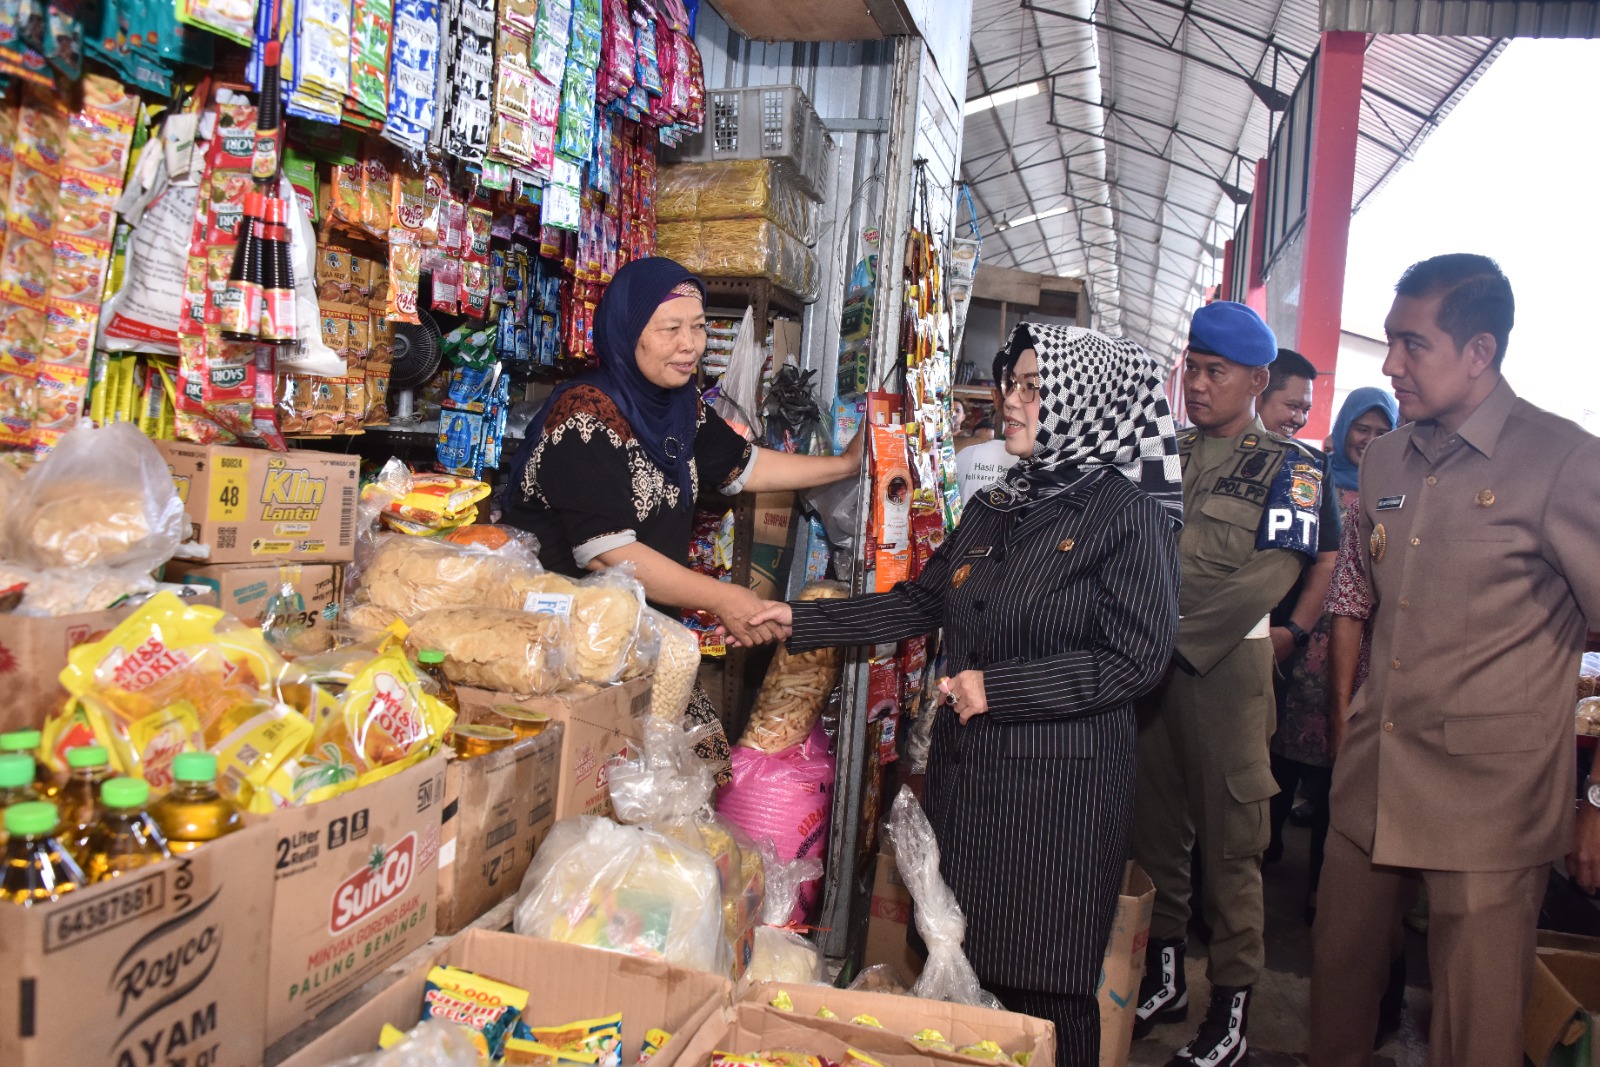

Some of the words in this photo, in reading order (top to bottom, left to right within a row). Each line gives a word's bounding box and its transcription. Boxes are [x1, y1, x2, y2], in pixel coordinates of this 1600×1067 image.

[225, 138, 254, 151] AORI
[212, 367, 245, 382] SAORI
[974, 462, 995, 472] Hasil
[219, 486, 240, 508] 48
[260, 468, 327, 505] Klin
[1216, 480, 1242, 496] POL
[1244, 486, 1265, 500] PP
[260, 504, 321, 522] Lantai
[763, 512, 788, 527] SIMPAN
[1267, 508, 1317, 545] PT
[276, 837, 291, 870] 2
[291, 829, 320, 849] Liter
[335, 850, 411, 928] SunCo
[307, 934, 356, 971] MINYAK
[355, 909, 399, 945] GORENG
[398, 893, 421, 919] BAIK
[115, 924, 217, 1018] Royco
[288, 952, 355, 1002] PALING
[115, 1000, 218, 1067] AYAM
[431, 1004, 488, 1031] GELAS
